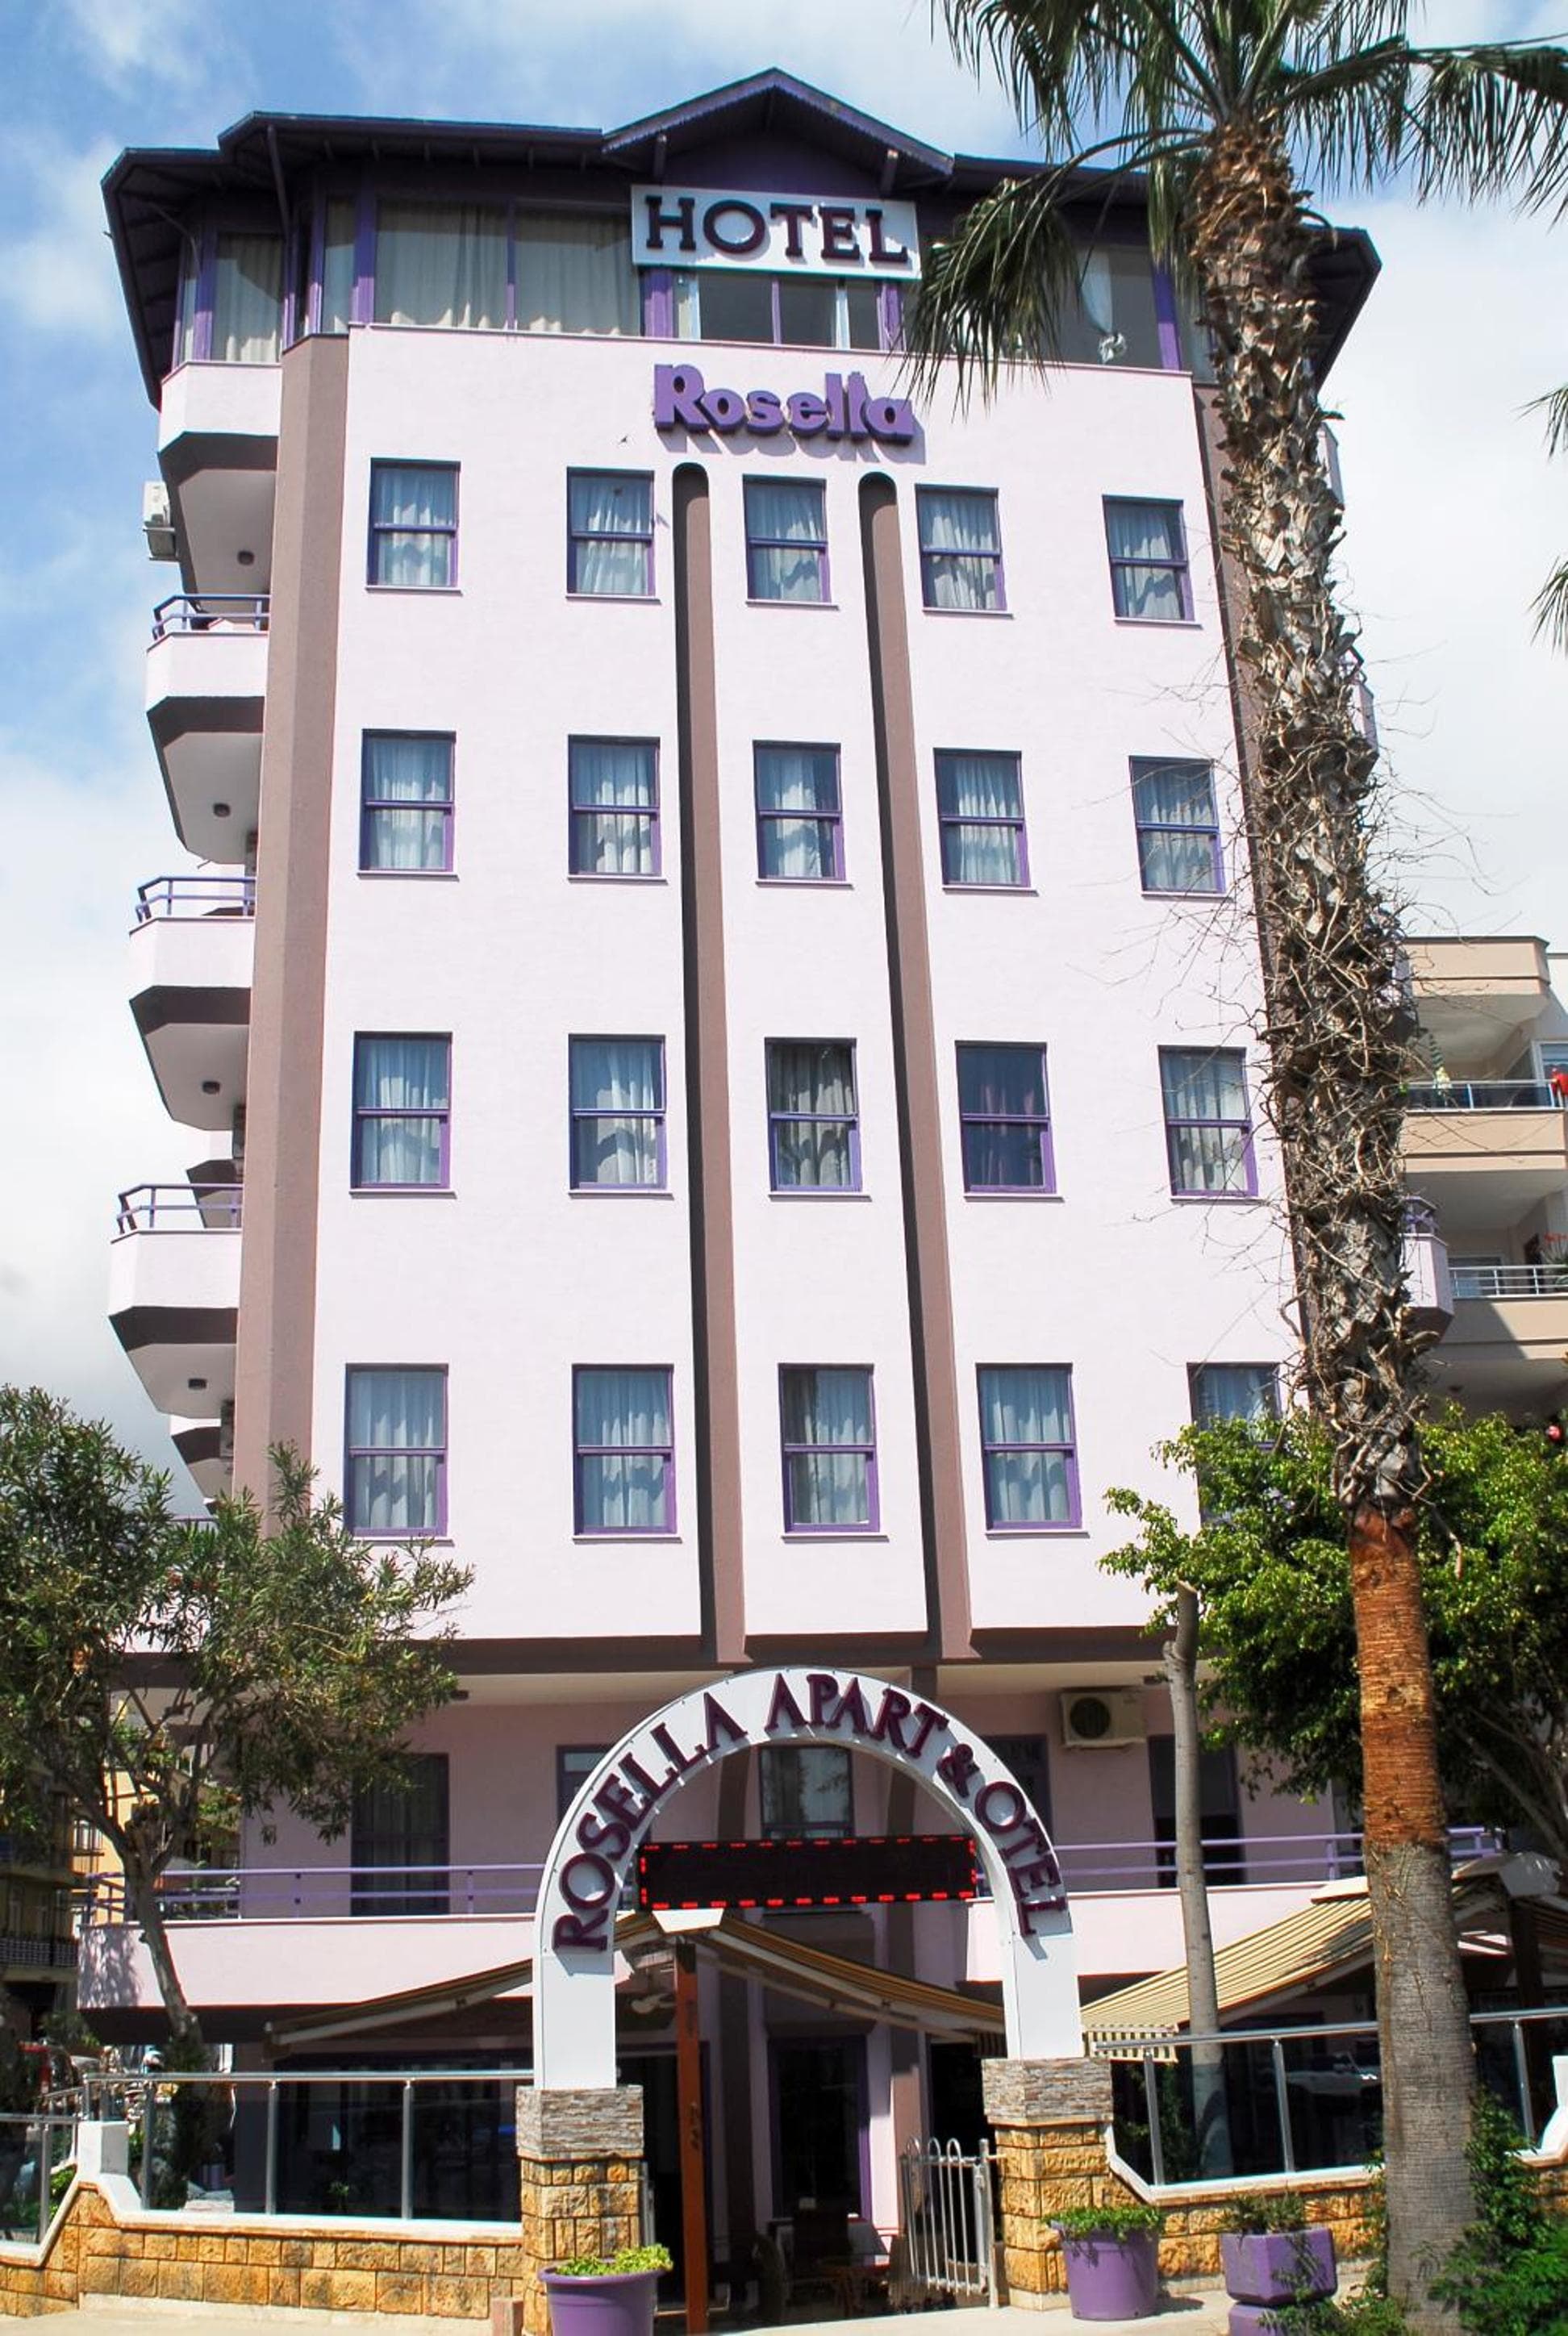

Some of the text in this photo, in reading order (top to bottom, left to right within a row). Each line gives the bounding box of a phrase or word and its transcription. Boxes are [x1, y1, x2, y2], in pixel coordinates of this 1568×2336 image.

[646, 196, 909, 263] HOTEL
[654, 364, 915, 444] Rosella
[552, 1692, 748, 1951] ROSELLA
[765, 1672, 949, 1758] APART
[974, 1781, 1069, 1938] OTEL
